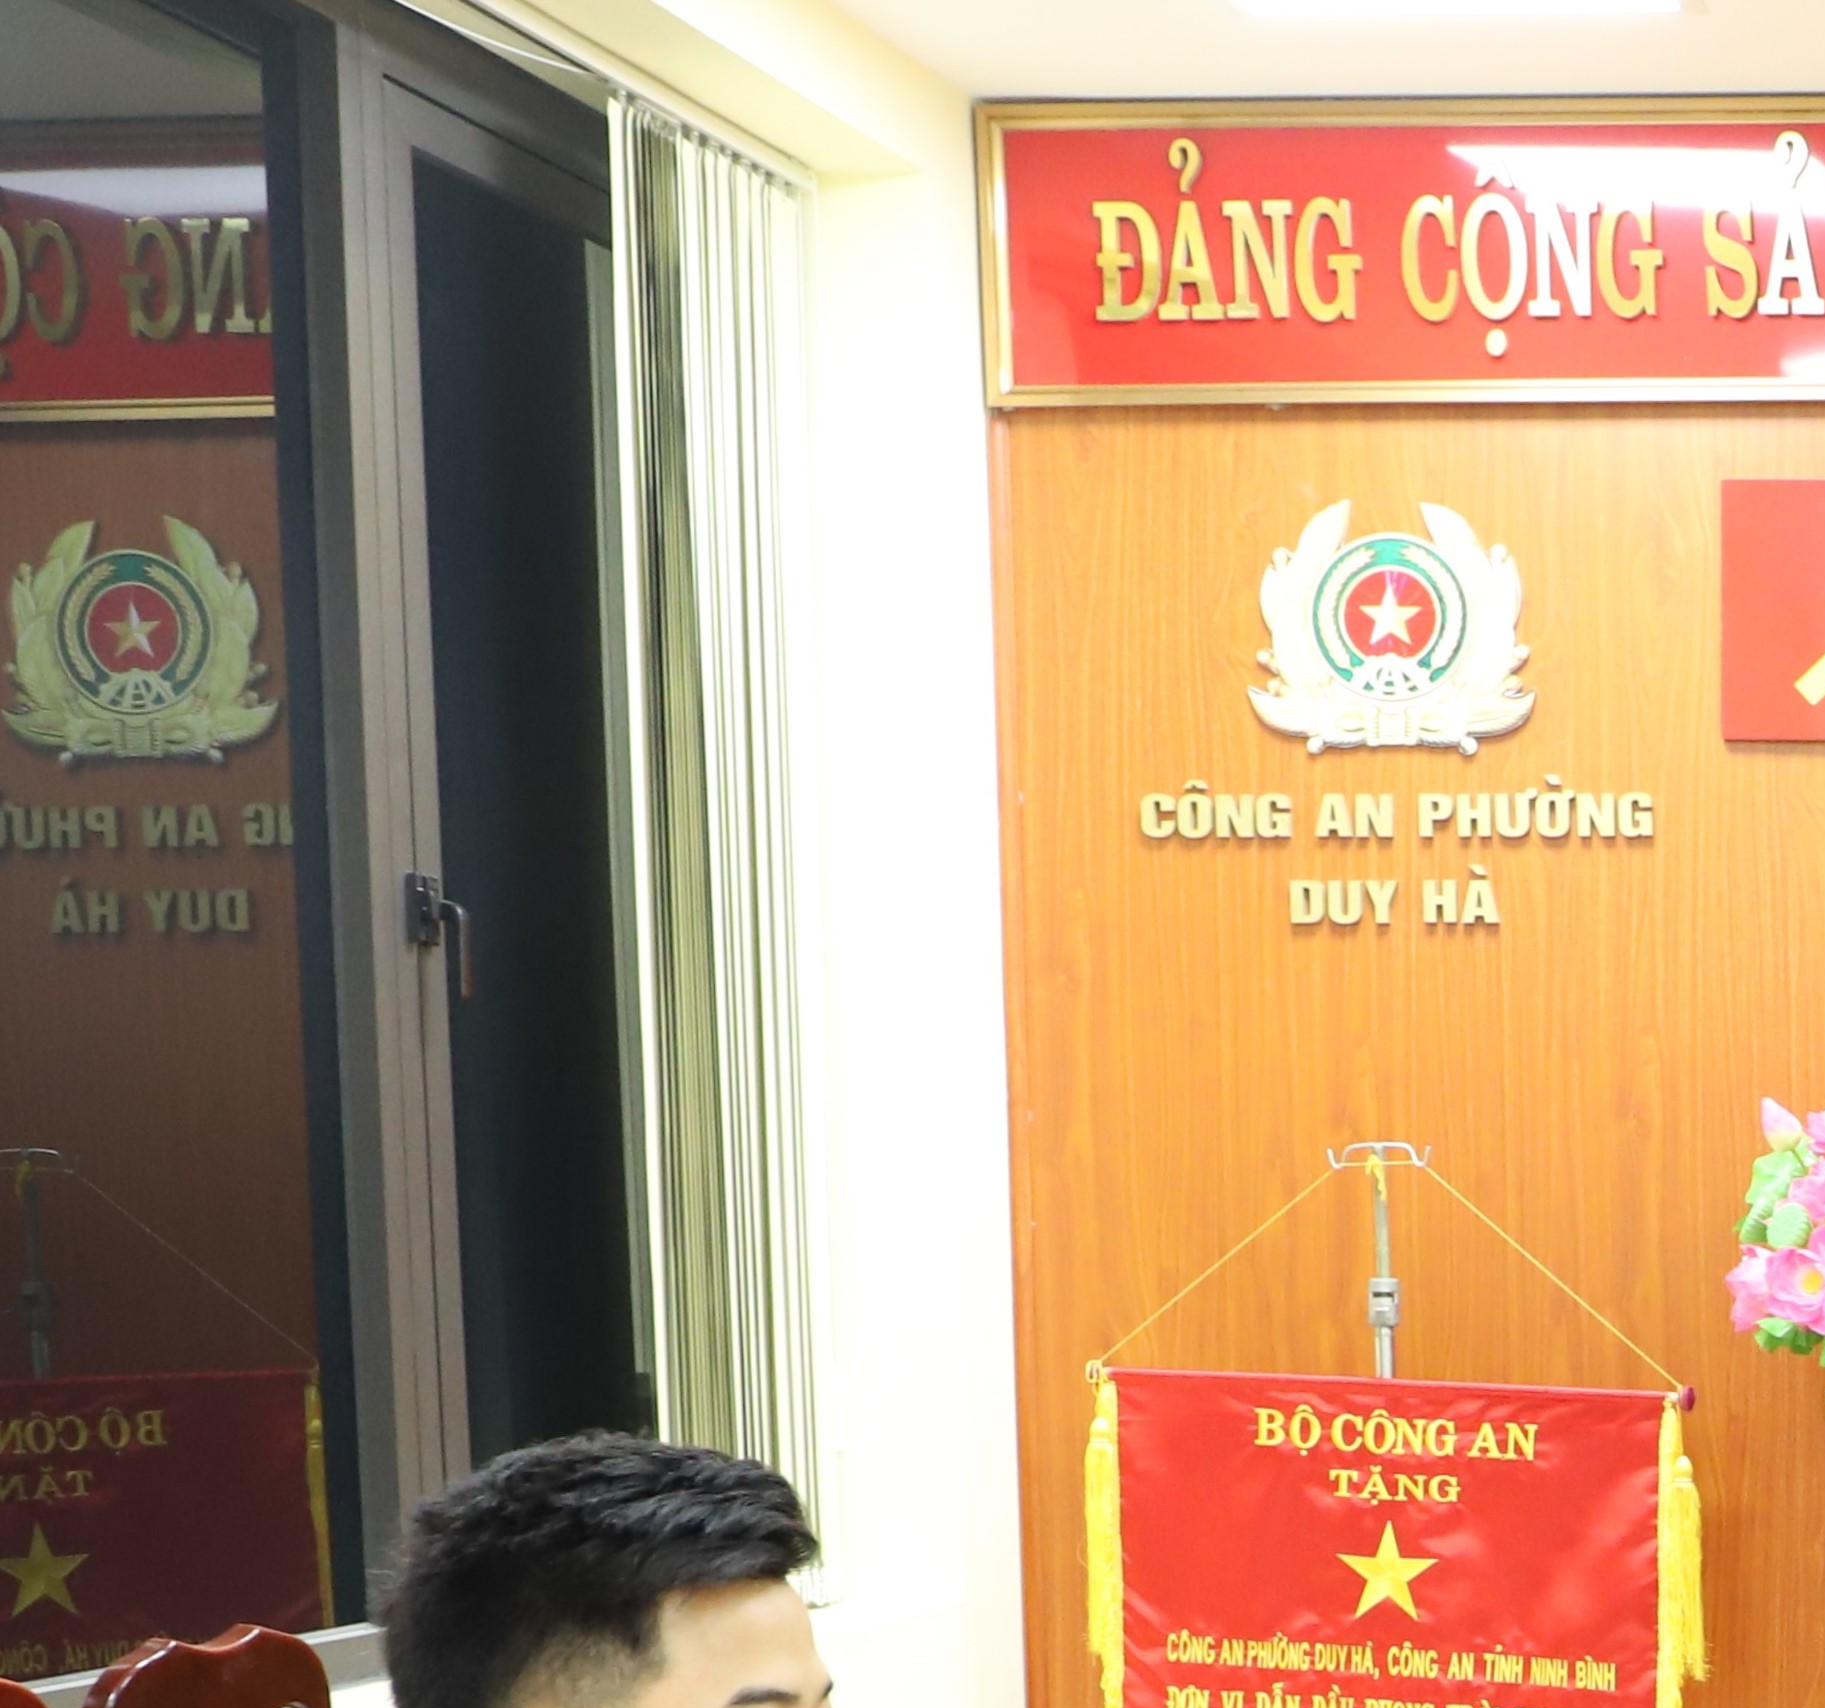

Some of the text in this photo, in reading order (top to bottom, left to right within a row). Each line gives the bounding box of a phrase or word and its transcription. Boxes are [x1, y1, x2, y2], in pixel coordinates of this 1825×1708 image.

[1092, 137, 1362, 323] ĐẢNG
[1401, 155, 1664, 357] CỘNG
[1140, 774, 1655, 840] CÔNG AN PHƯỜNG
[1289, 865, 1501, 926] DUY HÀ
[1253, 1404, 1538, 1462] BỘ CÔNG AN
[1329, 1465, 1461, 1505] TẶNG
[1167, 1629, 1615, 1690] CÔNG AN PHƯỜNG DUY HÀ, CÔNG AN TỈNH NINH BÌNH
